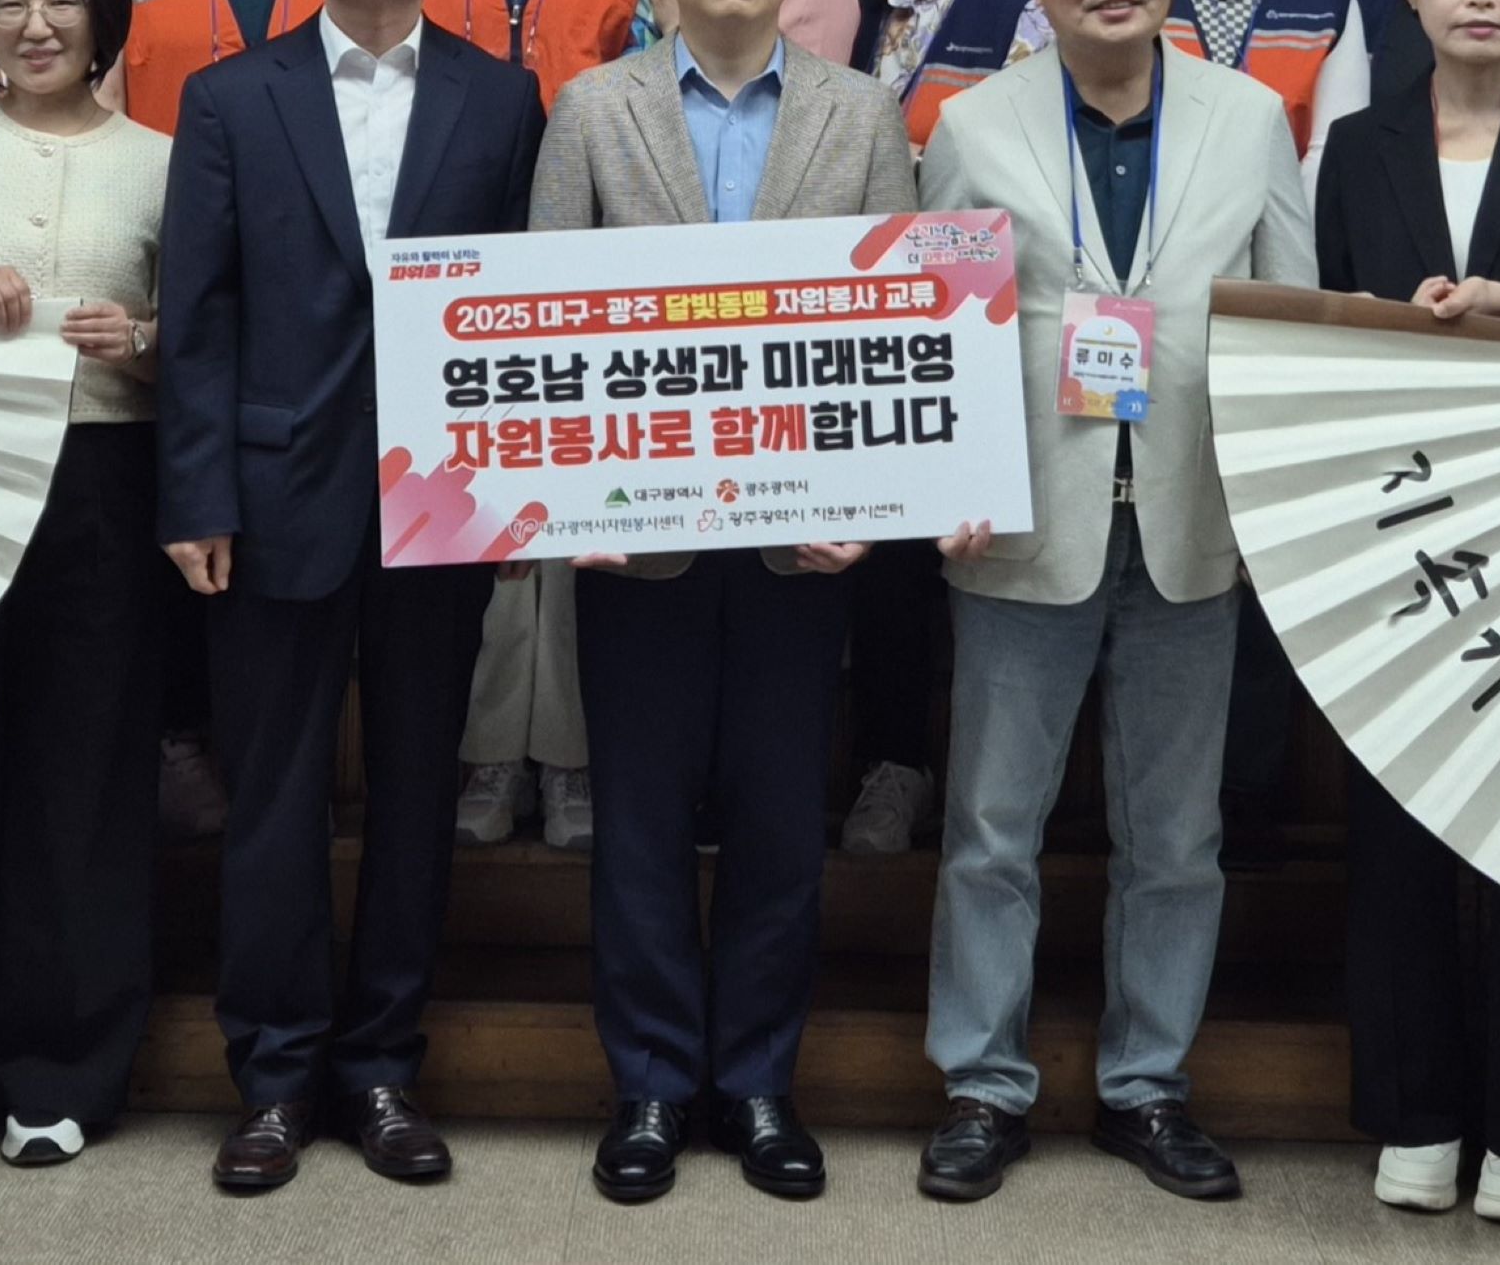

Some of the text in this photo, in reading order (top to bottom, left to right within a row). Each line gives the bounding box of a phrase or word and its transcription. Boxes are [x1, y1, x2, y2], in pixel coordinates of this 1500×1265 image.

[446, 261, 482, 277] 대구
[456, 304, 532, 333] 2025
[665, 290, 768, 322] 달빛동맹
[774, 284, 878, 317] 자원봉사
[884, 281, 937, 310] 교류
[443, 332, 956, 408] 영호남 상생과 미래번영
[445, 395, 958, 470] 자원봉사로 함께합니다
[634, 486, 704, 501] 대구광역시
[745, 480, 810, 496] 광주광역시
[729, 503, 905, 527] 광주광역시 자원봉사센터
